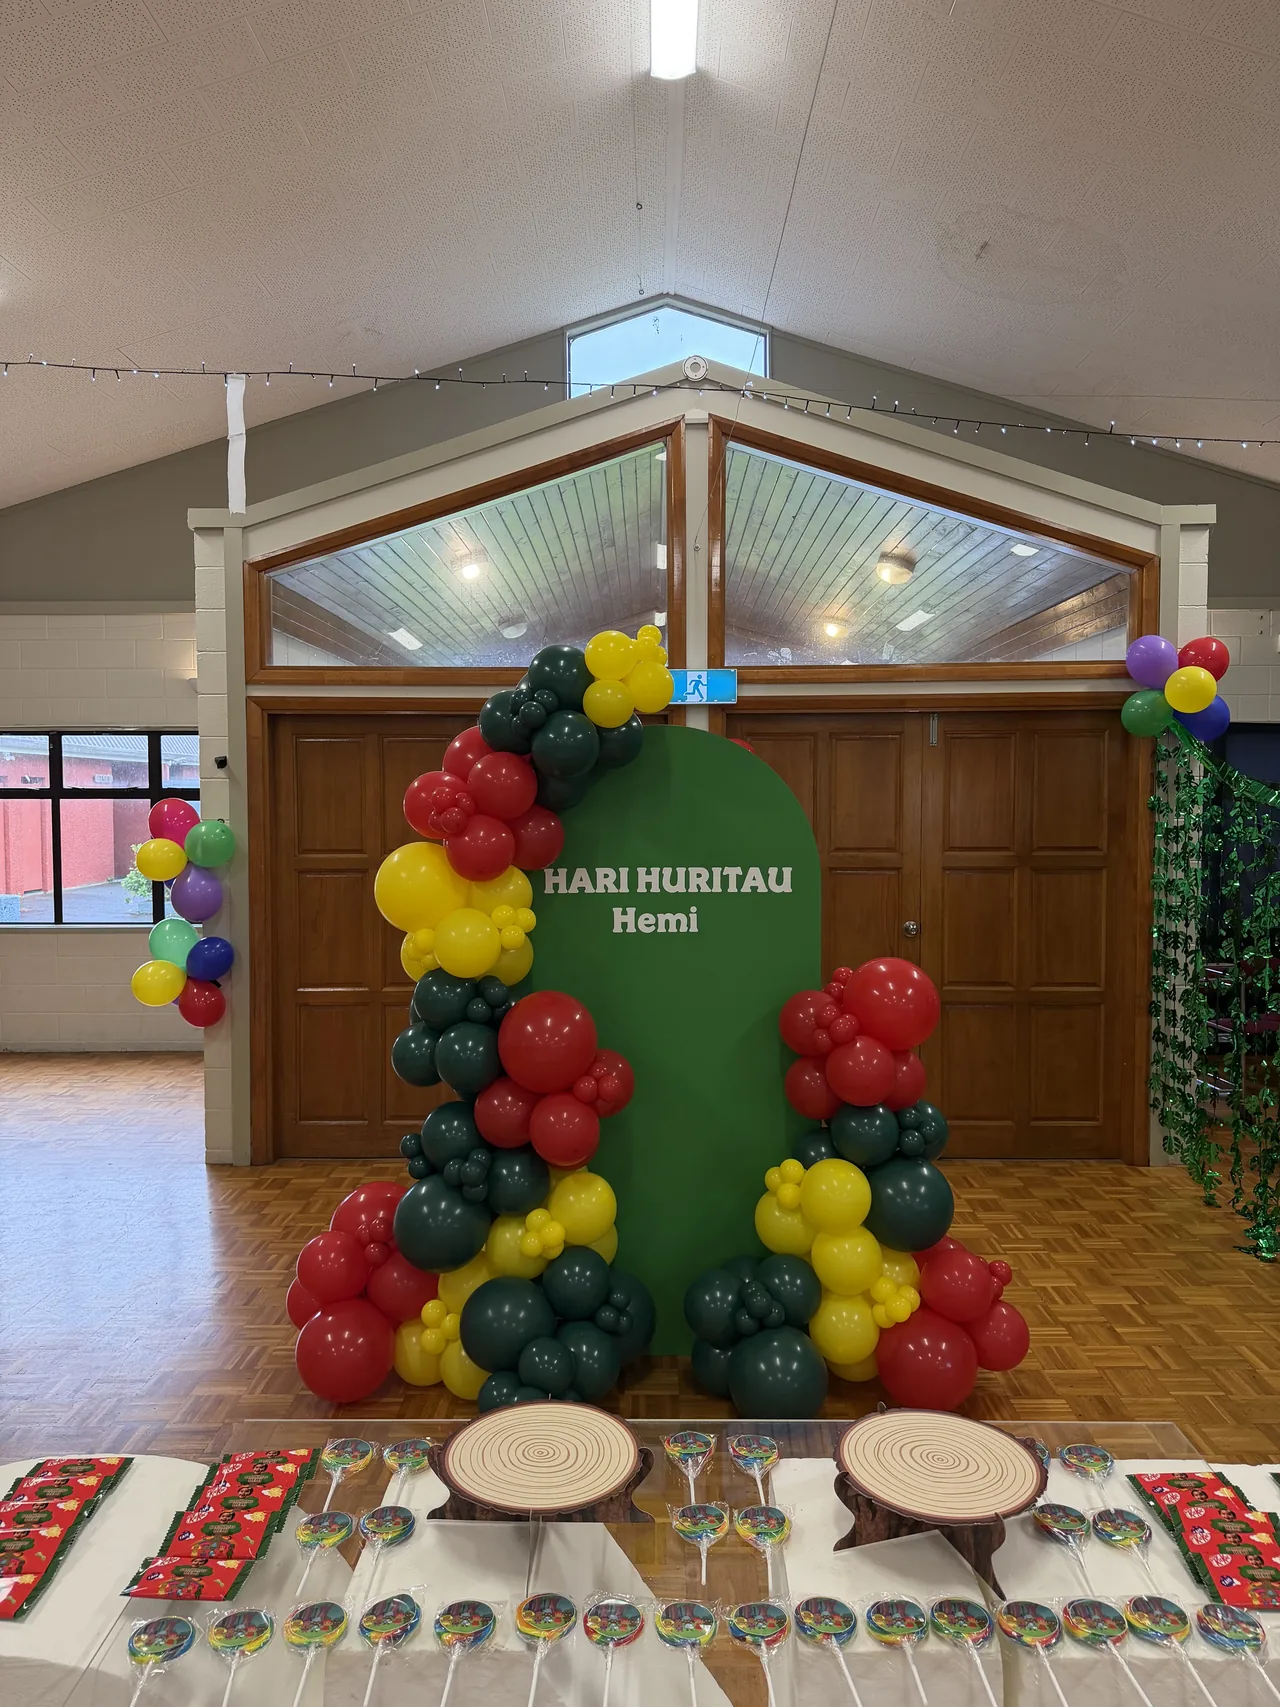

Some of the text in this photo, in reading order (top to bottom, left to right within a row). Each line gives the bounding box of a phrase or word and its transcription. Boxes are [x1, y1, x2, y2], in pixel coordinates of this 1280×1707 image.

[544, 866, 793, 893] HARI HURITAU
[612, 906, 698, 933] Hemi
